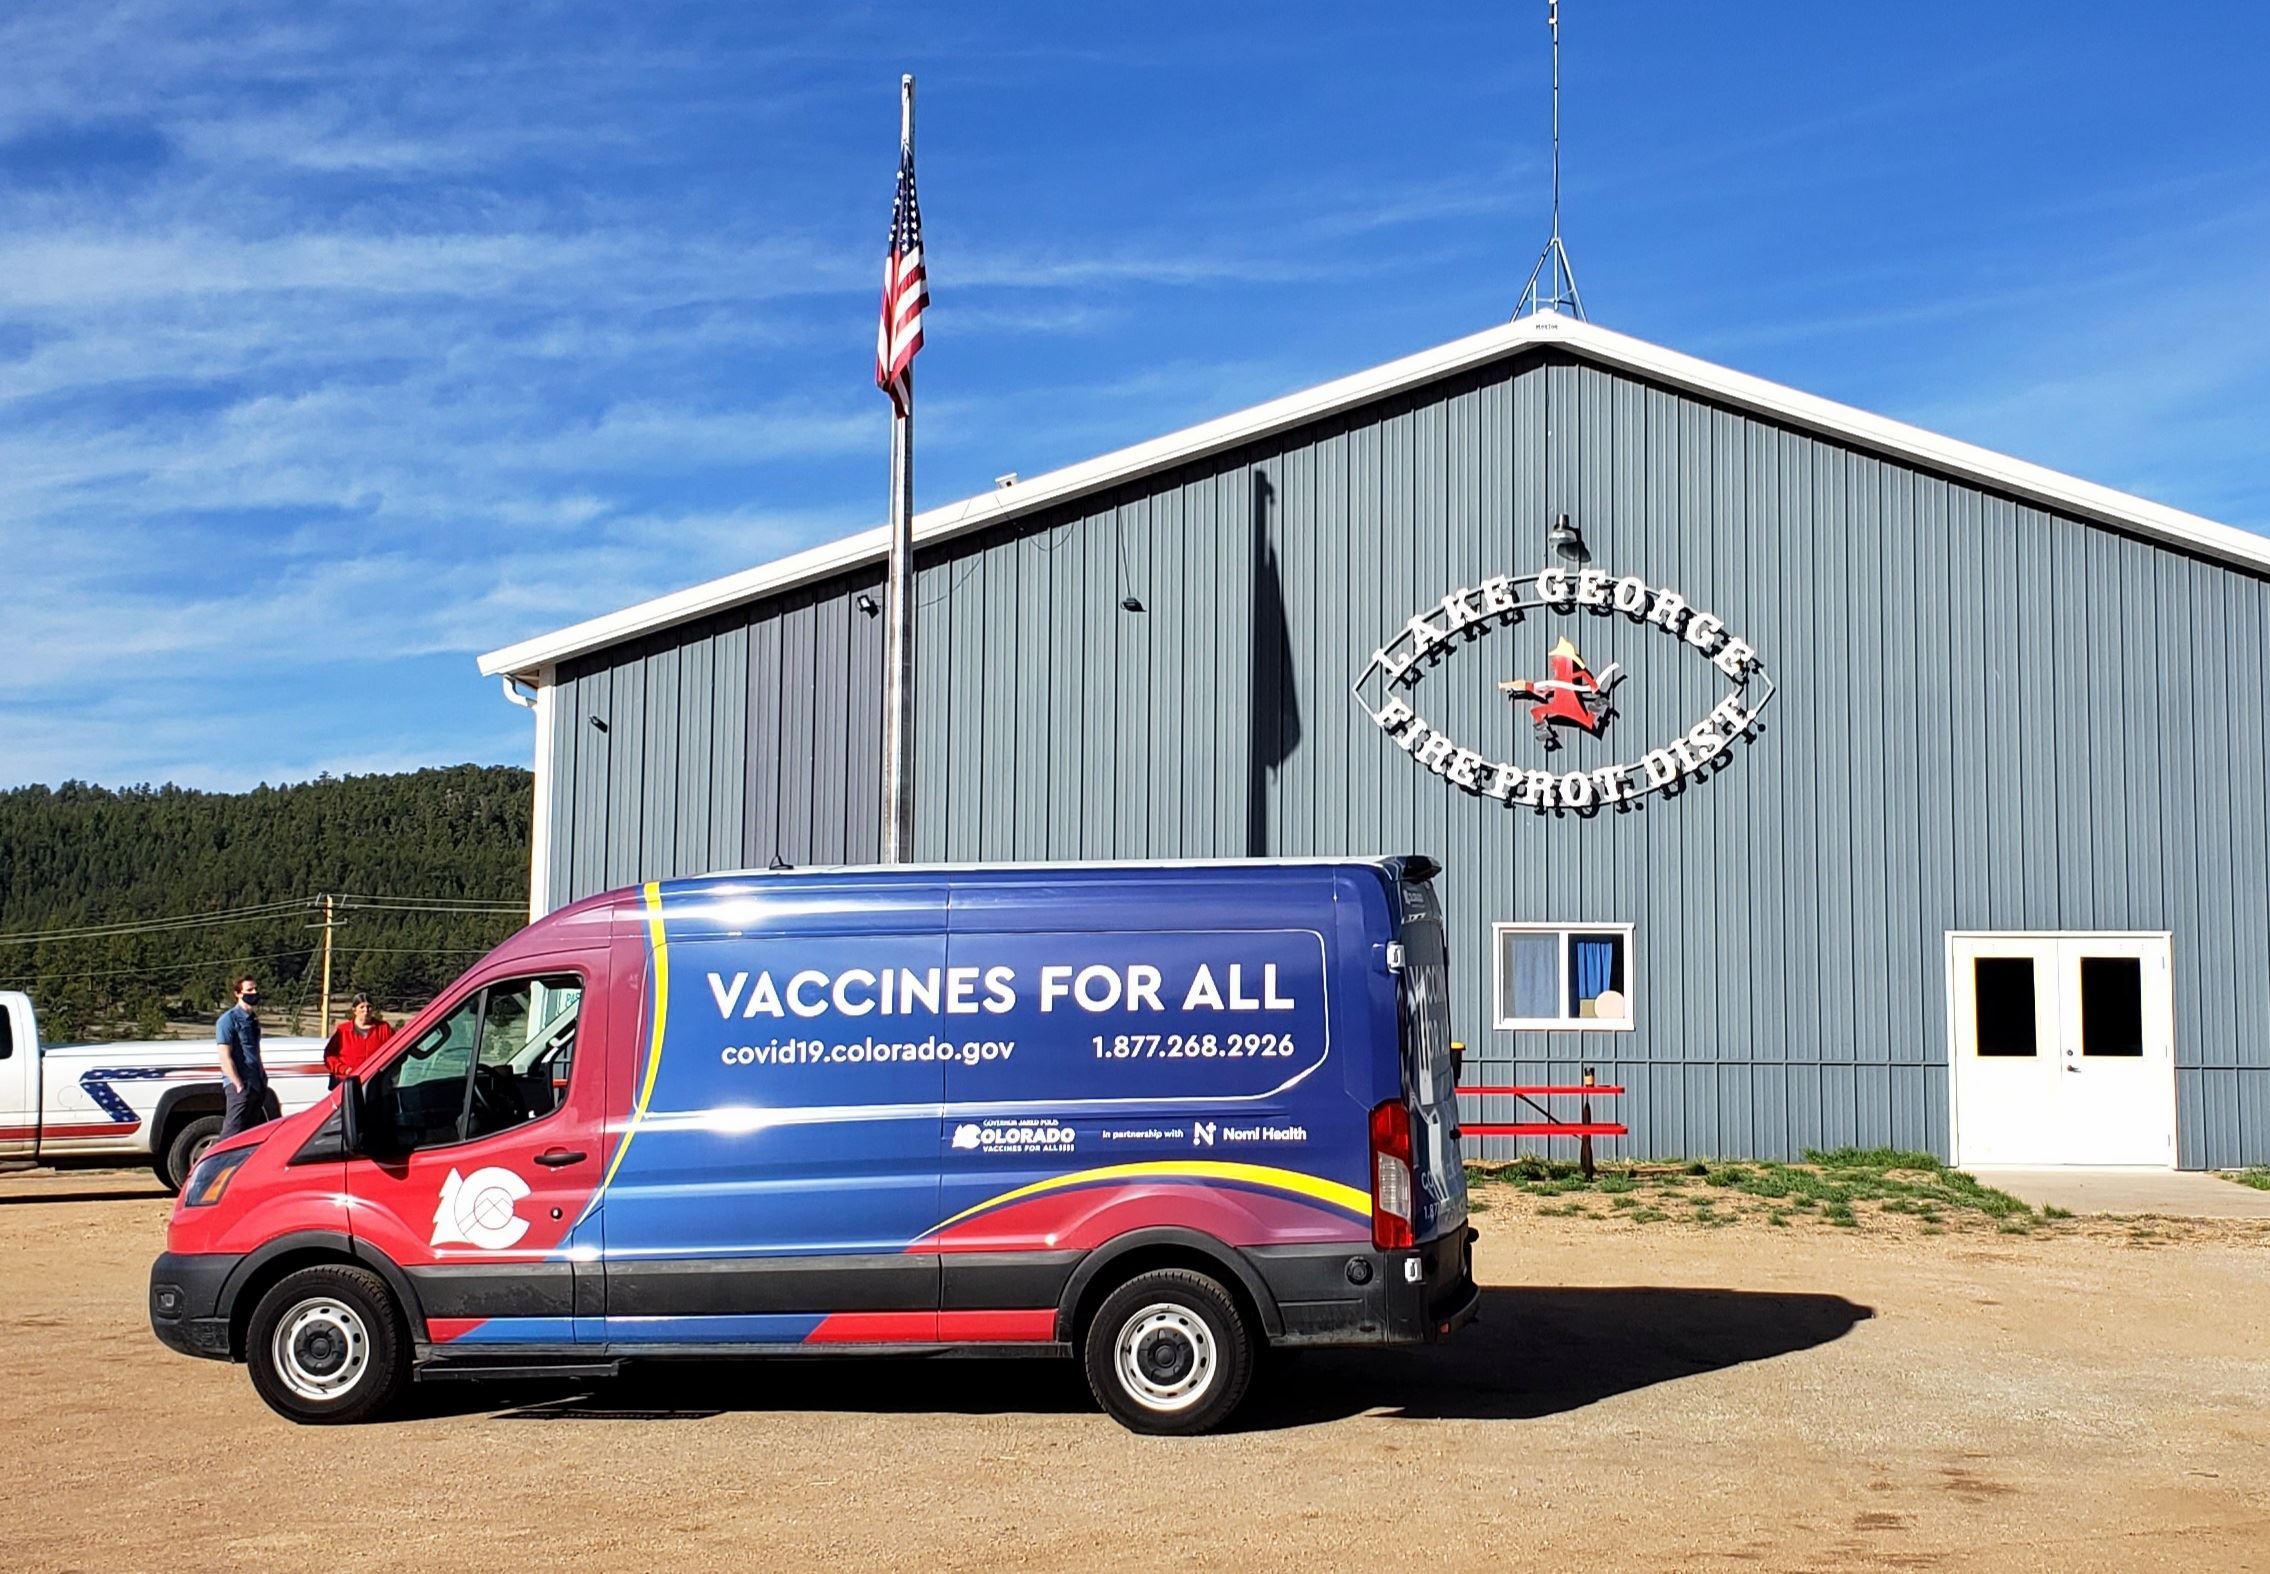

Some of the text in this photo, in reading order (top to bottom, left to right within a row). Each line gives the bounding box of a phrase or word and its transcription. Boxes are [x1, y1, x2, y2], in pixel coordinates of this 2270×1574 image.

[1372, 567, 1755, 678] LAKE GEORGE
[1374, 693, 1758, 807] FIRE PROT. DIST.
[707, 962, 1295, 1020] VACCINES FOR ALL
[721, 1035, 1015, 1066] covid19.colorado.gov
[1092, 1033, 1295, 1059] 1.877.268.2926
[1112, 1128, 1163, 1140] partnership
[1164, 1128, 1184, 1138] with
[1222, 1125, 1307, 1141] Nomi Health
[982, 1144, 1022, 1152] VACCINES
[1024, 1144, 1041, 1152] FOR
